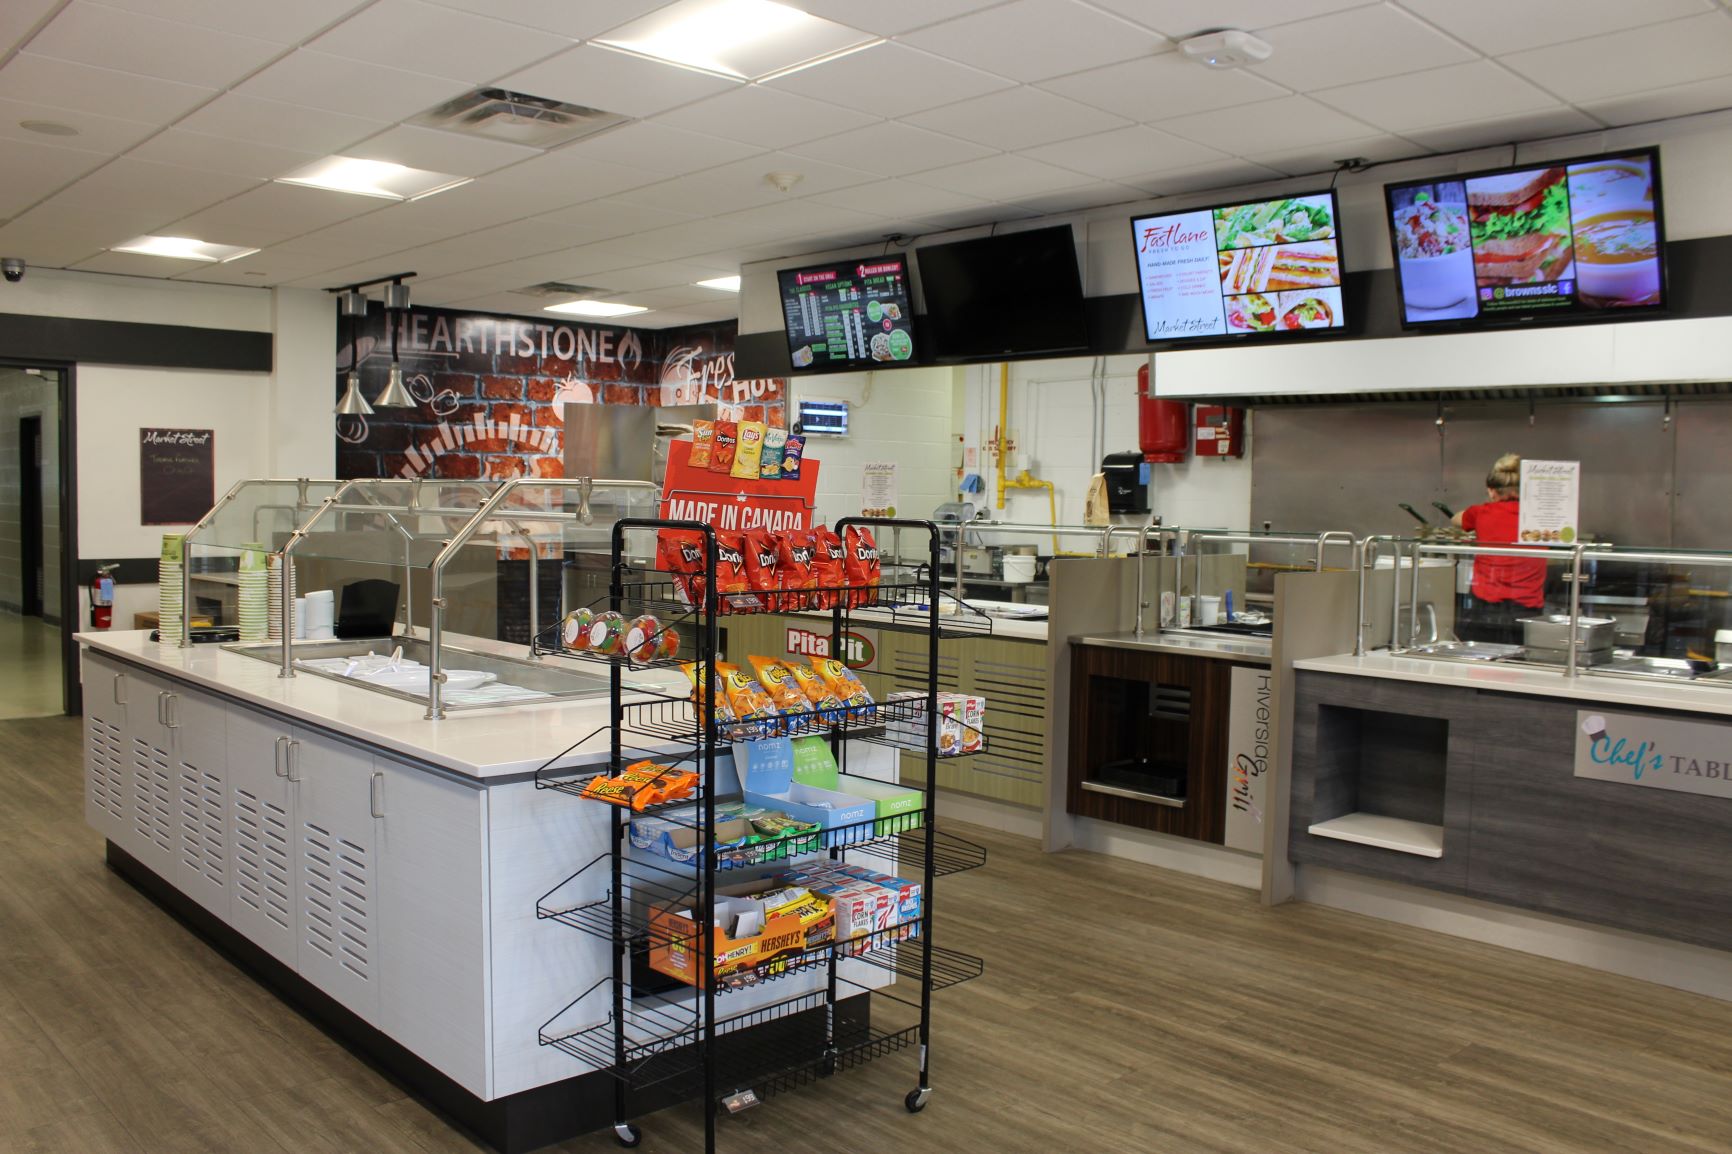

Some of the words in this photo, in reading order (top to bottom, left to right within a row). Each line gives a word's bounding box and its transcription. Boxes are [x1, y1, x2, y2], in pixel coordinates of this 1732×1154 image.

[1141, 223, 1209, 253] Fastlane
[385, 311, 615, 364] HEARTHSTONE
[676, 345, 735, 405] Fres
[668, 498, 718, 524] MADE
[720, 504, 738, 531] IN
[740, 506, 803, 534] CANADA
[788, 629, 829, 657] Pita
[1254, 675, 1272, 773] Riverside
[1590, 735, 1664, 781] Chef's
[593, 782, 625, 795] Reese
[1232, 753, 1259, 812] Grill
[840, 808, 865, 821] nomz
[890, 799, 912, 809] nomz
[760, 930, 801, 953] HERSHEY'S
